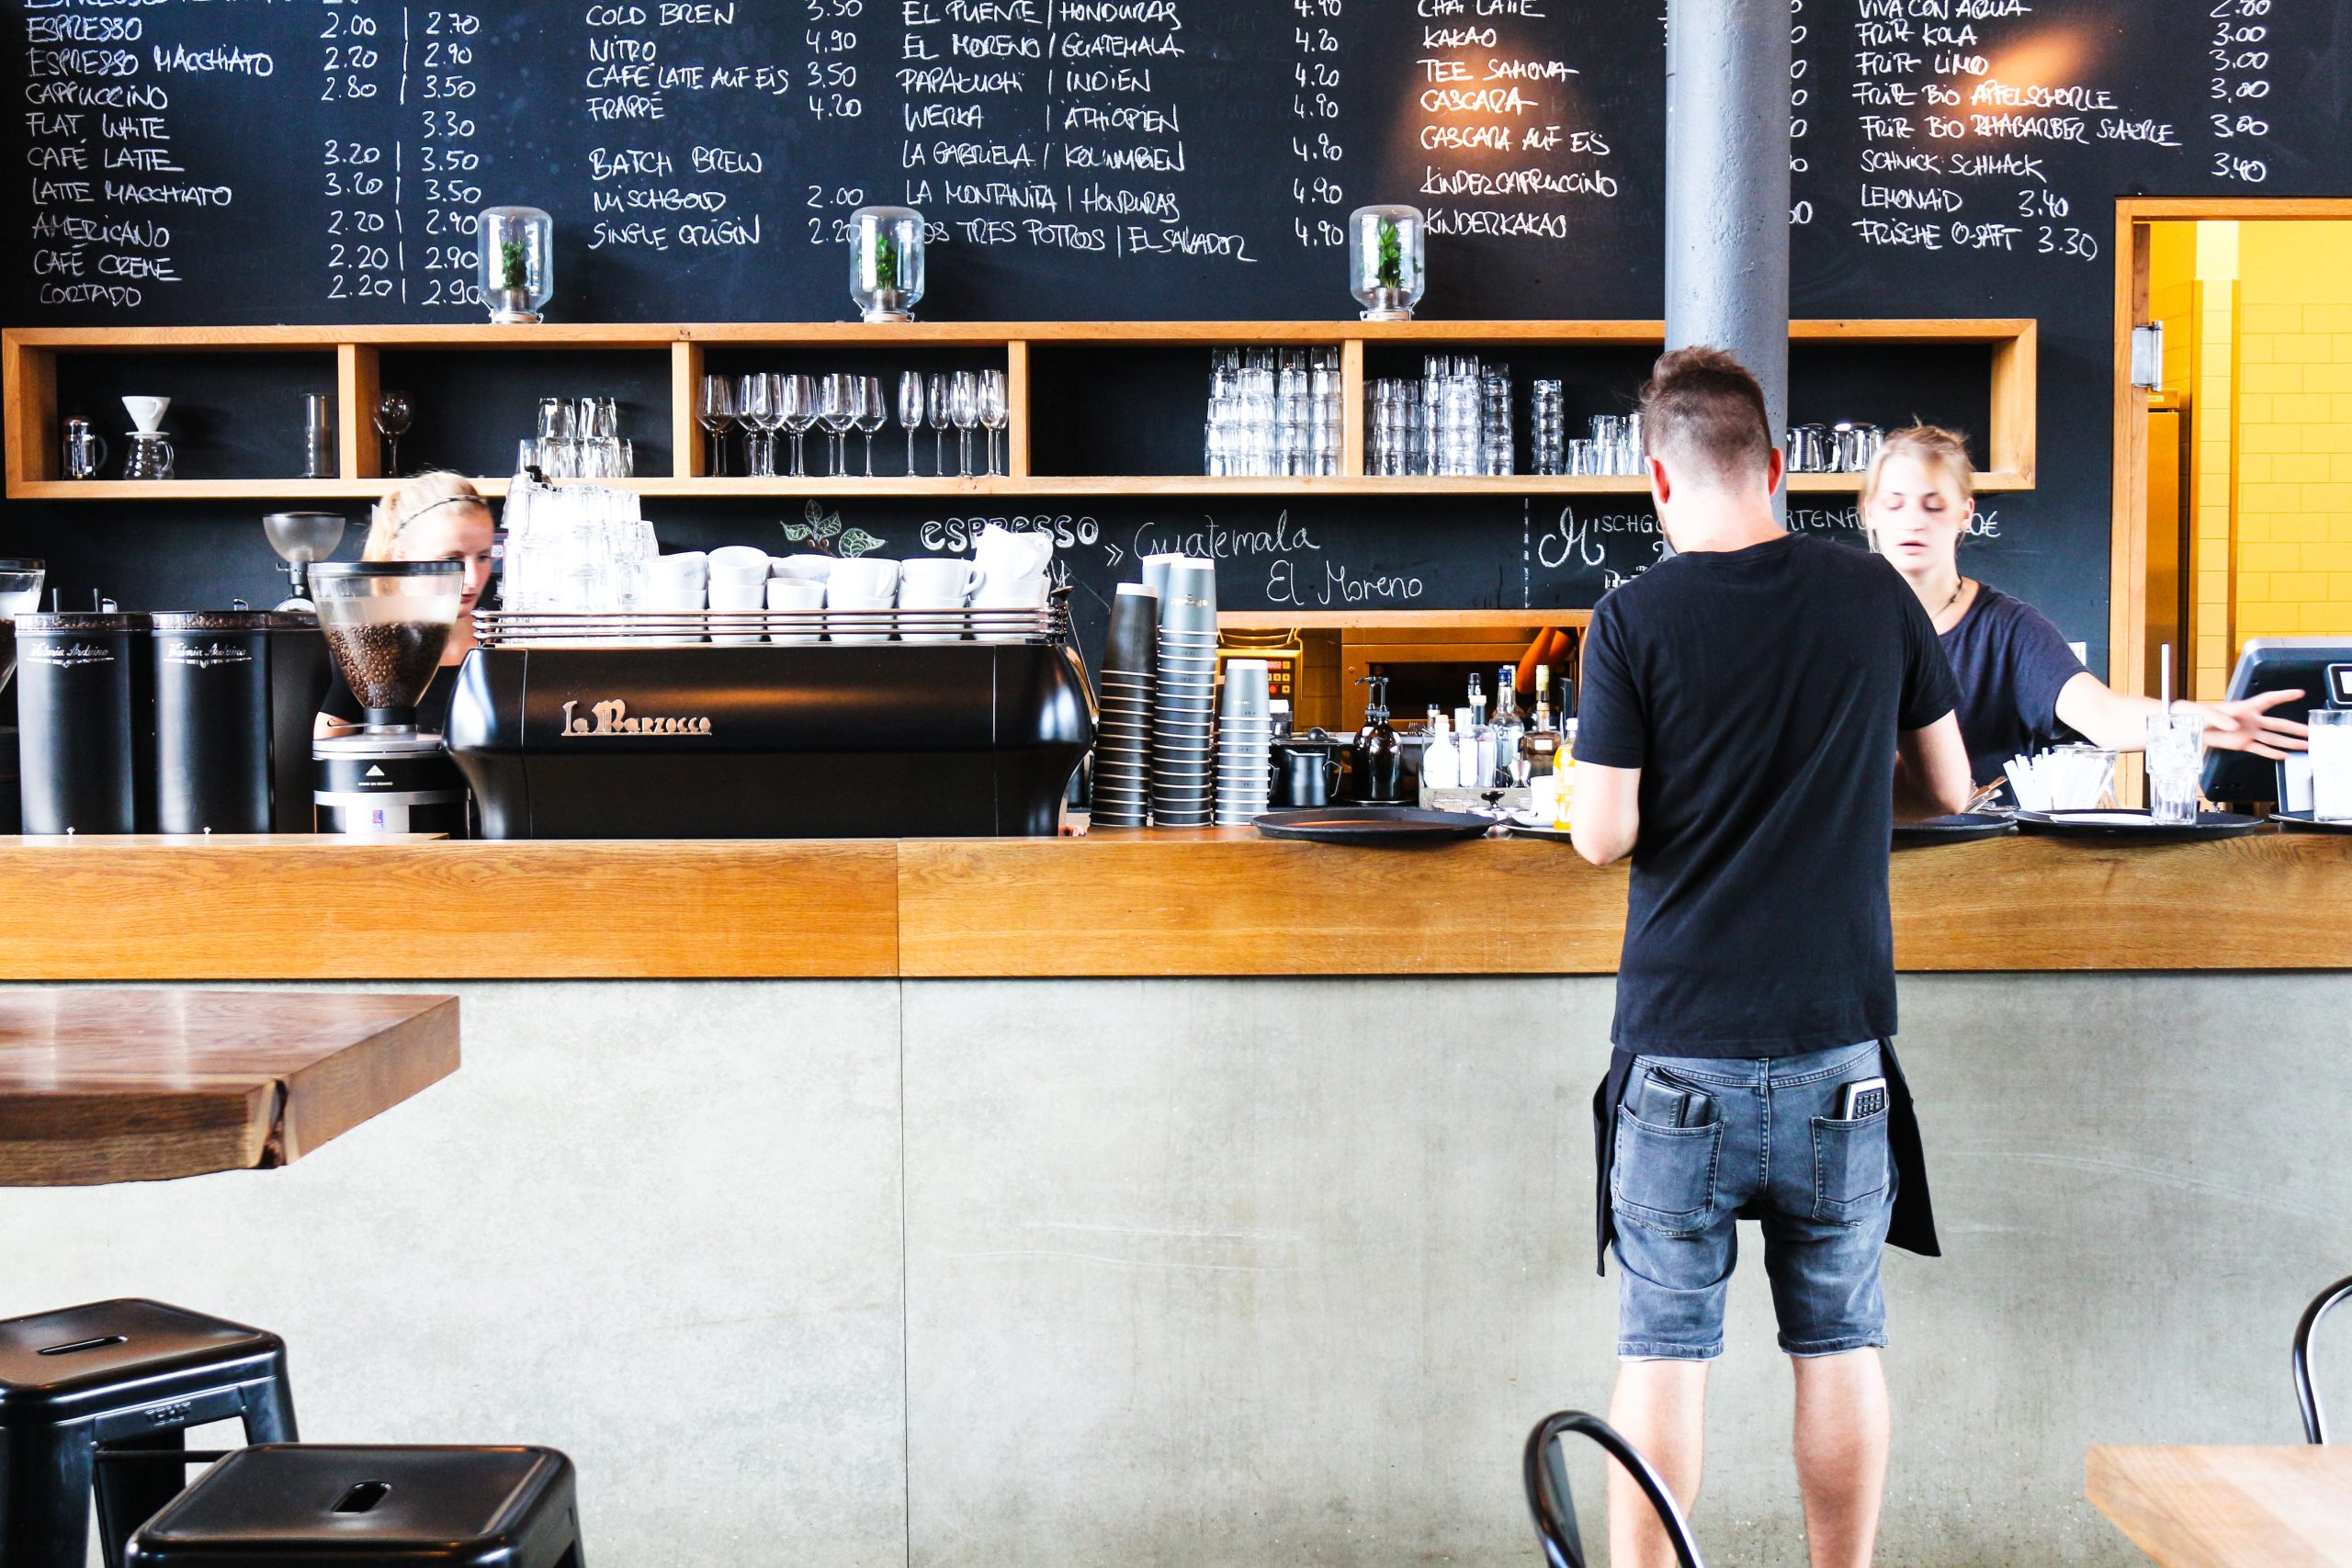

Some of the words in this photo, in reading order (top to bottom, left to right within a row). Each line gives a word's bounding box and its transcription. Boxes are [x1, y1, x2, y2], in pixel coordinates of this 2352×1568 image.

[321, 12, 377, 39] 2.00
[426, 11, 480, 35] 2.70
[585, 5, 647, 26] COLD
[901, 0, 941, 26] EL
[1059, 1, 1182, 30] HONDURAS
[26, 15, 142, 42] ESPRESSO
[806, 28, 856, 54] 4.90
[1295, 28, 1339, 52] 4.20
[1422, 25, 1498, 49] KAKAO
[1921, 23, 1979, 47] KOLA
[2212, 22, 2267, 46] 3.00
[424, 42, 472, 68] 2.90
[901, 33, 939, 60] EL
[1062, 32, 1185, 58] GUATEMALA
[25, 47, 139, 76] ESPRESSO
[323, 46, 378, 71] 2.20
[1416, 58, 1474, 83] TEE
[2209, 49, 2268, 71] 3.00
[423, 74, 476, 98] 3.50
[658, 67, 705, 90] LATTE
[807, 62, 856, 88] 3.50
[1295, 62, 1340, 87] 4.20
[322, 75, 377, 101] 2.80
[1419, 87, 1539, 115] CASCARA
[808, 94, 862, 120] 4.20
[904, 102, 985, 132] WERKA
[1294, 93, 1339, 118] 4.90
[26, 112, 85, 137] FLAT
[422, 110, 475, 139] 3.30
[1970, 113, 2090, 144] RHABARBER
[1293, 132, 1343, 162] 4.90
[1419, 125, 1514, 152] CASCARA
[28, 139, 89, 169] CAFÉ
[105, 148, 185, 172] LATTE
[324, 140, 380, 165] 3.20
[421, 147, 480, 172] 3.50
[588, 148, 673, 181] BATCH
[692, 146, 763, 174] BREW
[902, 140, 925, 168] LA
[33, 177, 94, 205] LATTE
[324, 172, 383, 197] 3.20
[424, 178, 481, 203] 3.50
[807, 186, 864, 209] 2.00
[906, 180, 932, 204] LA
[1293, 176, 1343, 204] 4.90
[2018, 189, 2069, 217] 3.40
[327, 210, 384, 235] 2.20
[425, 209, 479, 235] 2.90
[922, 221, 950, 244] OS
[956, 218, 1016, 244] TRES
[1295, 218, 1344, 246] 4.90
[1127, 226, 1163, 254] EL
[2037, 226, 2098, 261] 3.30
[328, 243, 389, 269] 2.20
[424, 246, 479, 270] 2.90
[40, 283, 141, 307] CORTADO
[327, 275, 393, 299] 2.20
[421, 278, 481, 306] 2.90
[1266, 559, 1305, 605] El
[1317, 559, 1423, 604] Moreno
